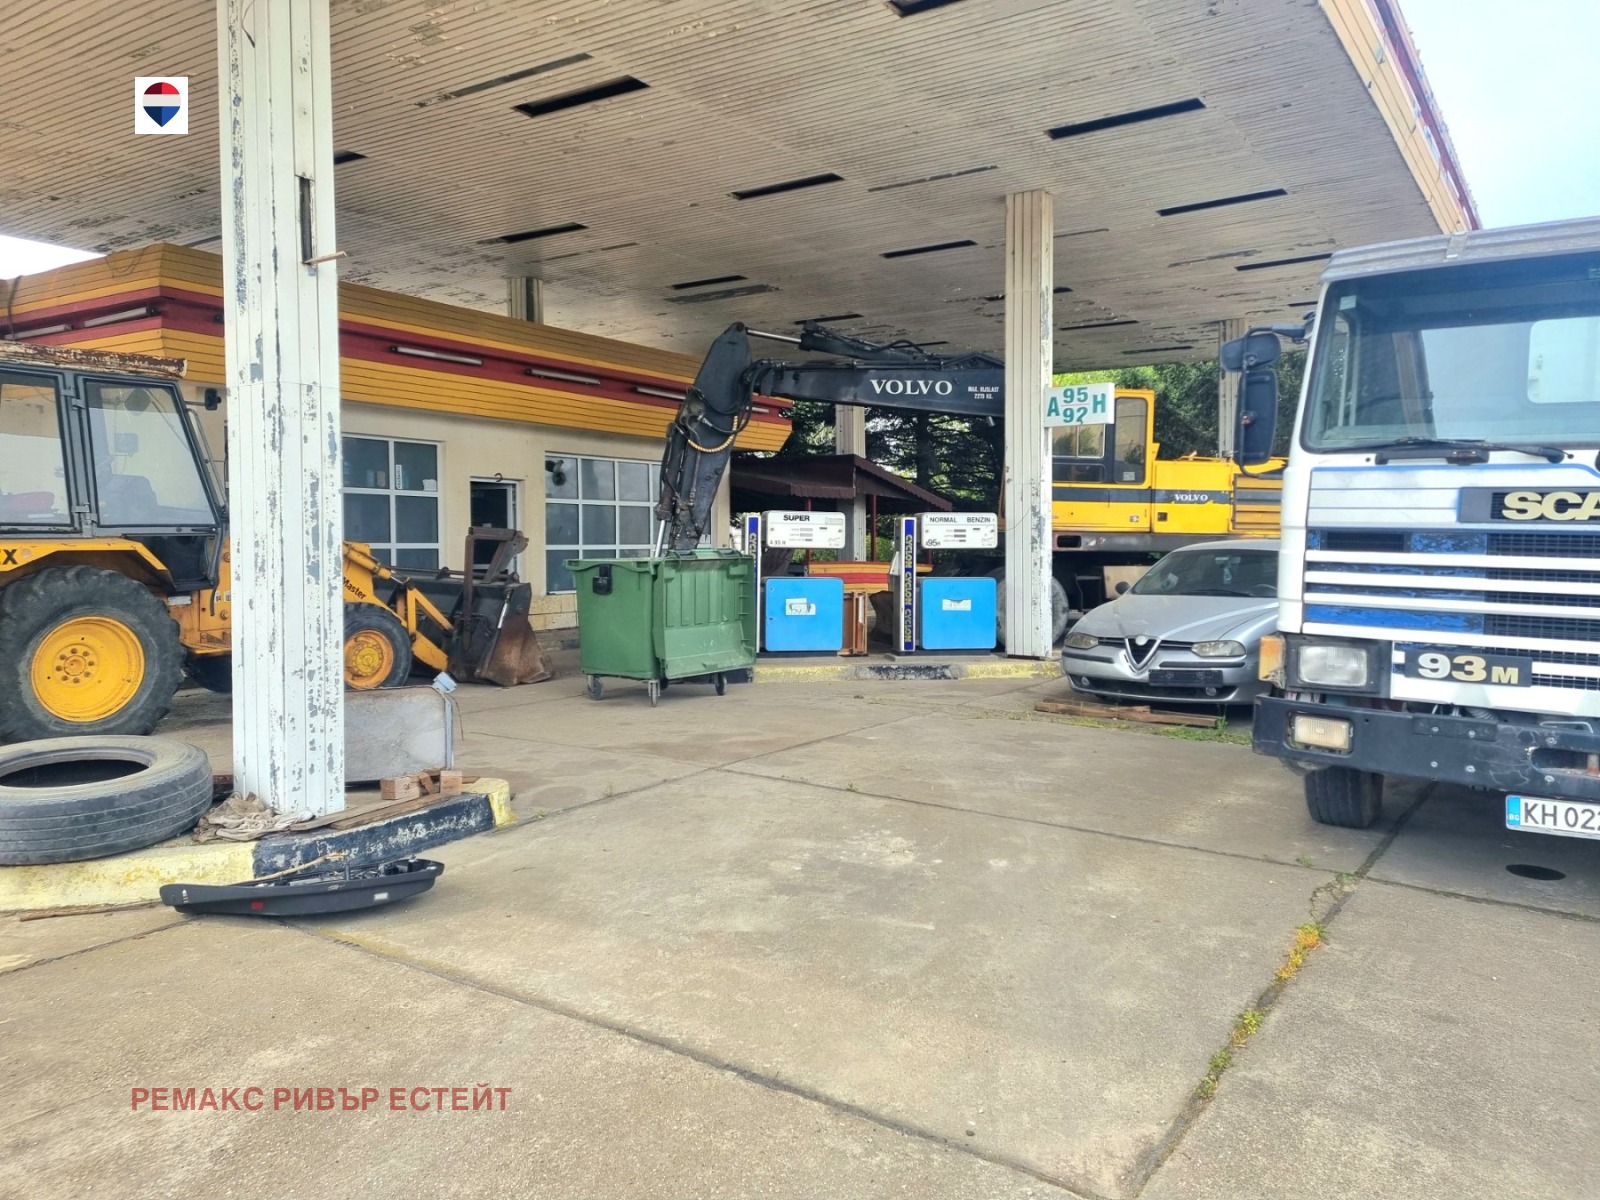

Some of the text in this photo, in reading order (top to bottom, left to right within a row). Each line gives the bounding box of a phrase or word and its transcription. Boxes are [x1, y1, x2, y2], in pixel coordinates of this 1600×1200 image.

[870, 379, 953, 396] VOLVO
[1047, 387, 1106, 417] A 95 H
[1062, 406, 1089, 423] 92
[1174, 494, 1208, 502] VOLVO
[783, 514, 810, 522] SUPER
[0, 549, 18, 565] X
[749, 533, 757, 567] CYCLO
[905, 534, 913, 568] CYCLON
[904, 572, 912, 605] CYCLON
[904, 608, 912, 642] CYCLON
[1418, 653, 1519, 685] 93 M
[1509, 813, 1520, 821] BG
[1524, 802, 1600, 831] KH 02
